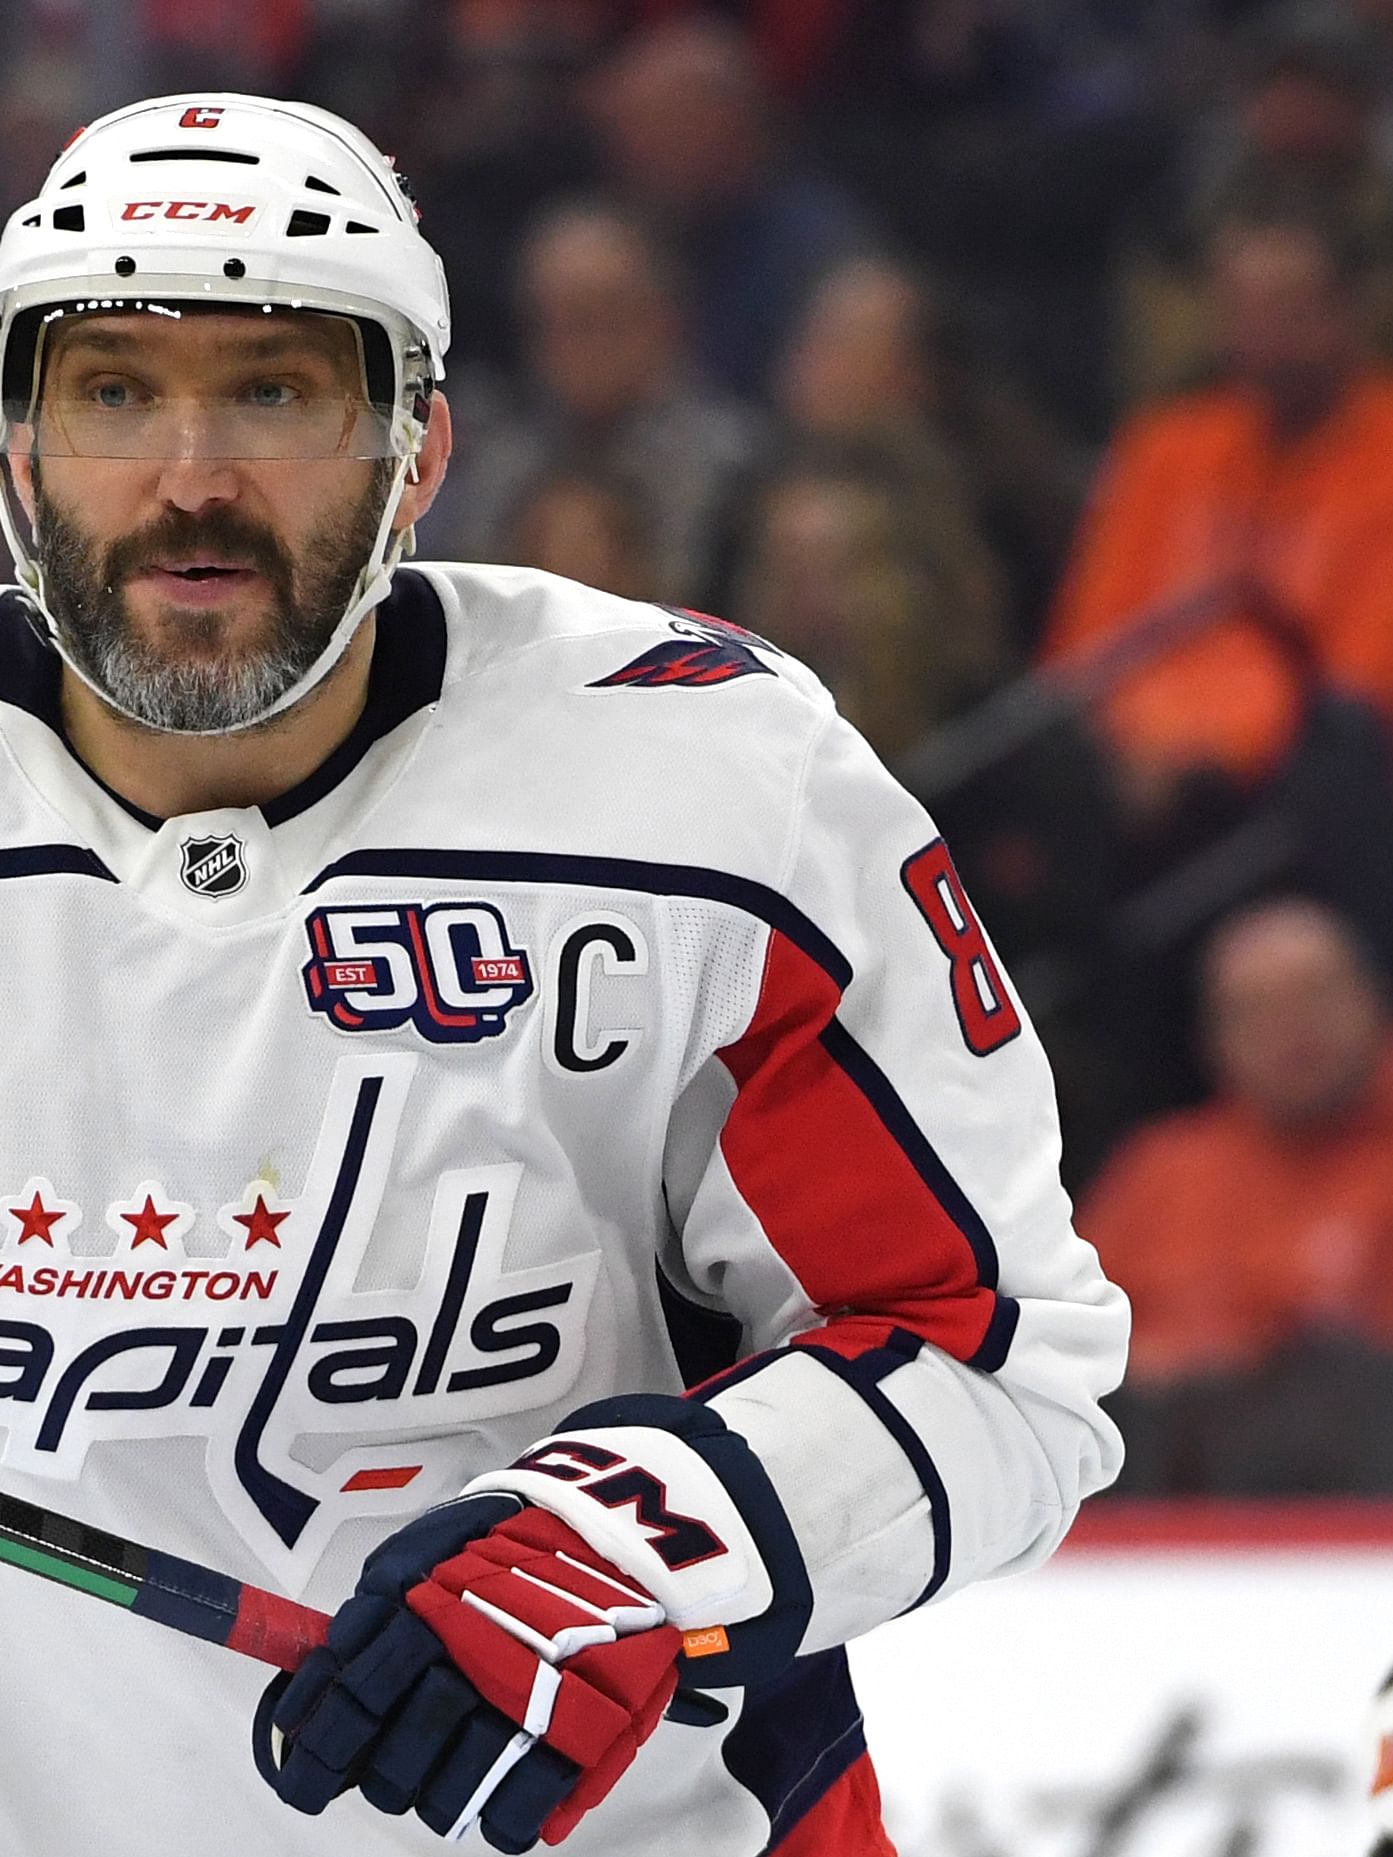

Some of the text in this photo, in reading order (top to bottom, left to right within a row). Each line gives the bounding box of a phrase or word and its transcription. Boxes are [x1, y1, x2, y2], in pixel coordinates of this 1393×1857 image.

[120, 201, 257, 224] CCM
[194, 849, 234, 886] NHL
[319, 904, 516, 1017] 50
[335, 967, 367, 982] EST
[477, 963, 519, 979] 1974
[899, 836, 1022, 1058] 8
[553, 923, 636, 1073] C
[506, 1440, 730, 1573] CM
